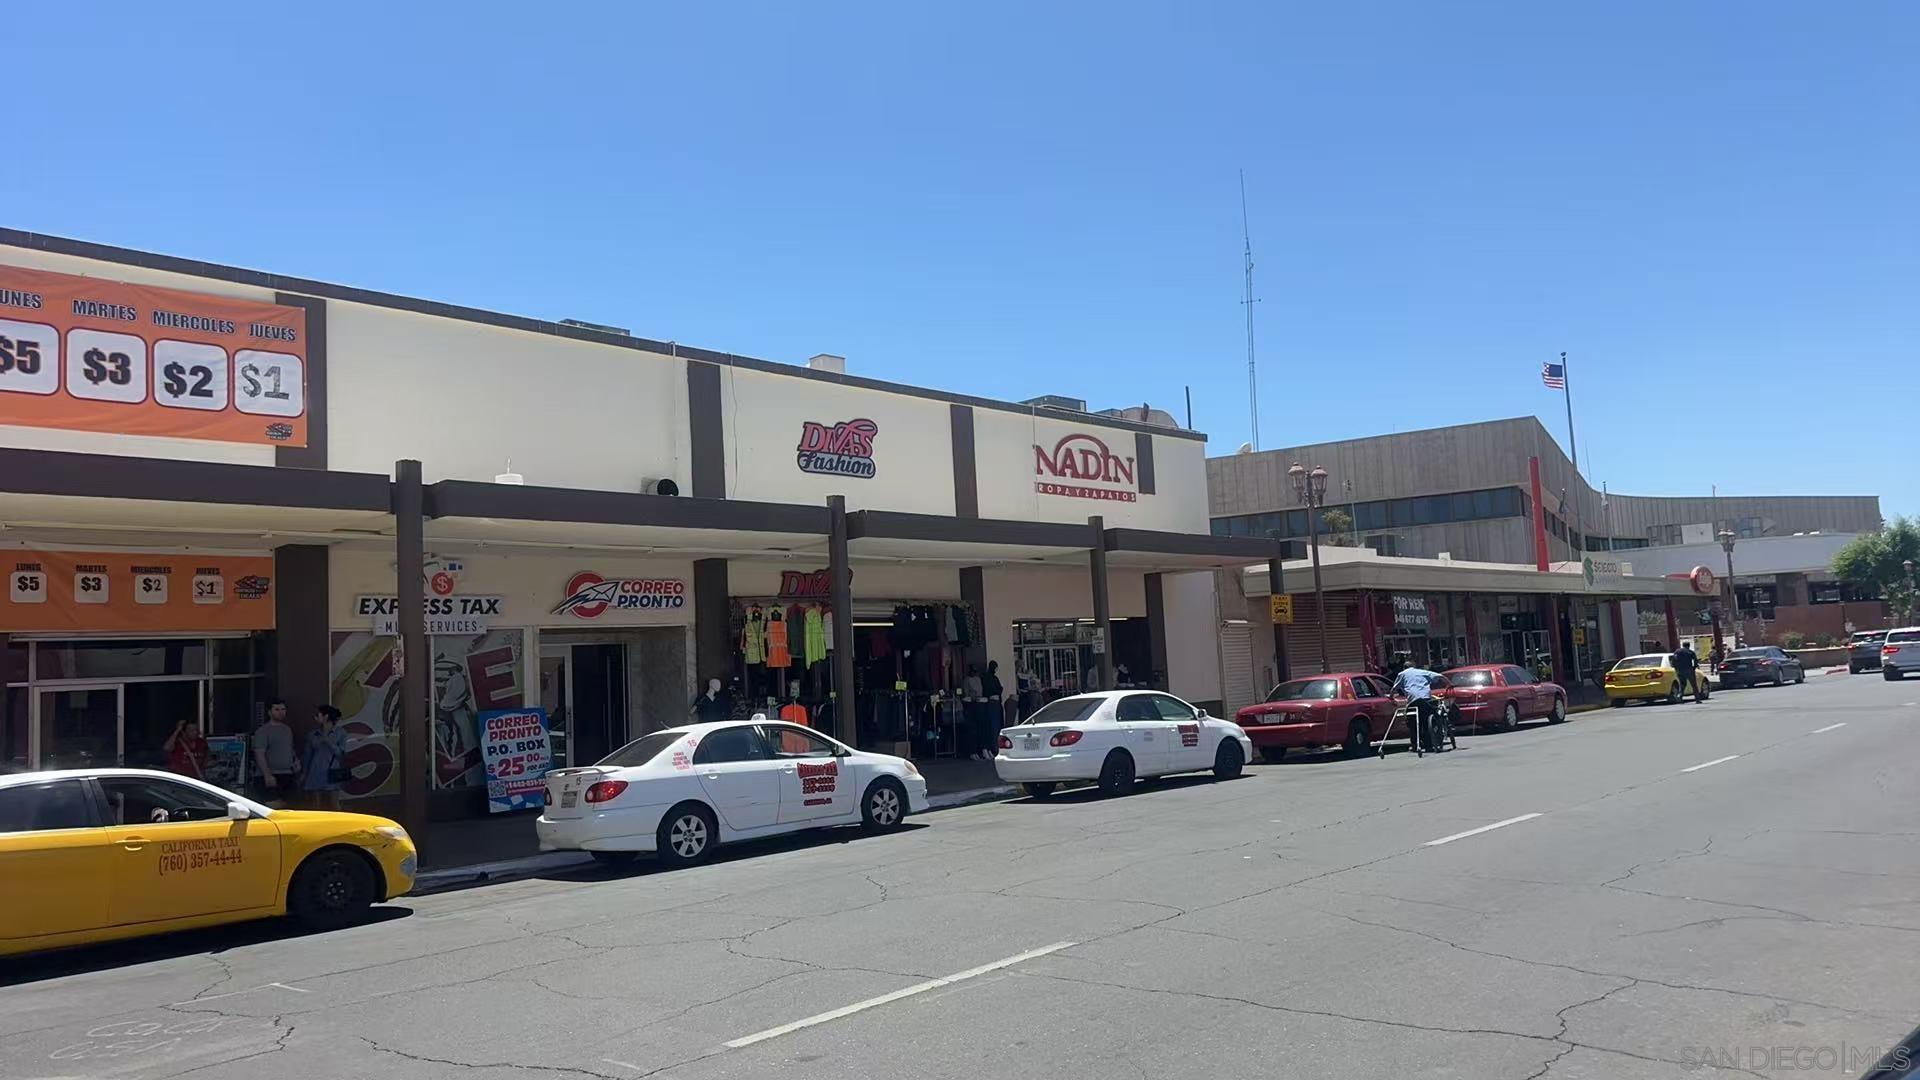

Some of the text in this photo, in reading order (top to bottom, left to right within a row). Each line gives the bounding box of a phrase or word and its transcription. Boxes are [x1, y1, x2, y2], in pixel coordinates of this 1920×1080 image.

[73, 299, 137, 321] MARTES
[152, 311, 235, 334] MIERCOLES
[249, 323, 296, 341] JUEVES
[83, 347, 131, 385] $3
[163, 361, 213, 398] $2
[241, 363, 289, 400] $1
[799, 420, 877, 457] DIVAS
[799, 452, 873, 475] Fashion
[1032, 442, 1135, 485] NADIN
[17, 575, 216, 597] $5 $3 $2 $1
[620, 581, 684, 595] CORREO
[460, 598, 500, 615] TAX
[617, 595, 683, 608] PRONTO
[487, 714, 539, 730] CORREO
[489, 726, 541, 742] PRONTO
[487, 739, 546, 756] P.O. BOX
[161, 836, 240, 854] CALIFORNIA TAXI
[159, 853, 187, 876] (760)
